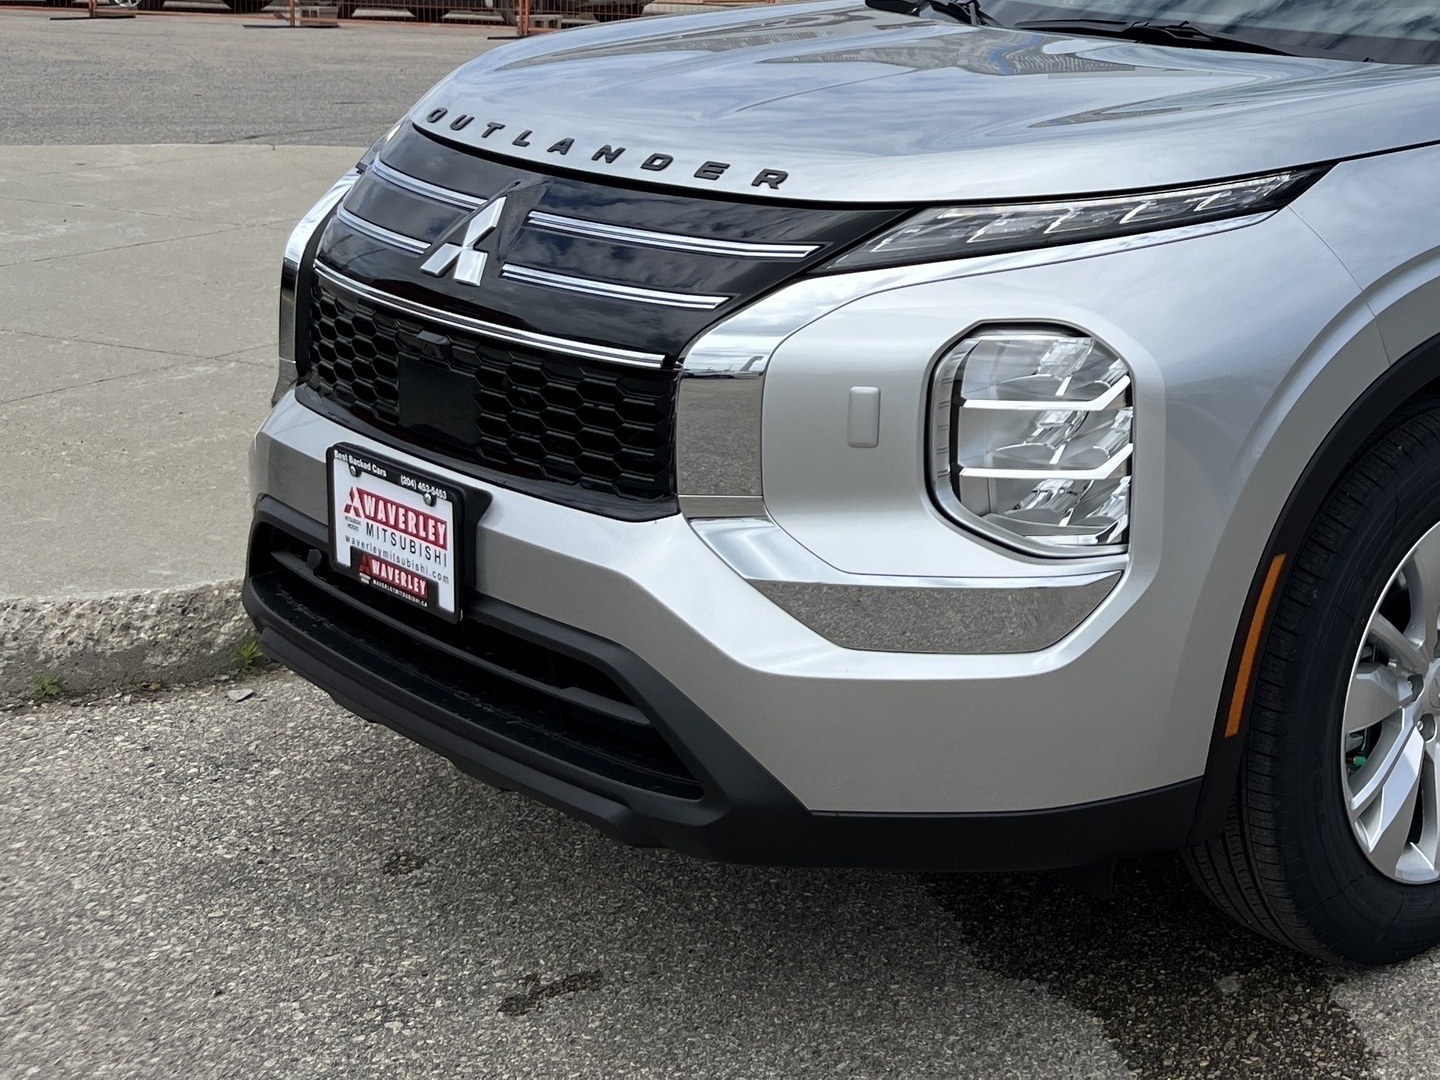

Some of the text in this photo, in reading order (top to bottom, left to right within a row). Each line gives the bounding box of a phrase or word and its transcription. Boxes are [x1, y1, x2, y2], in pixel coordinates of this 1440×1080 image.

[426, 107, 789, 190] OUTLANDER
[334, 450, 387, 477] Best Backed Cars
[401, 474, 416, 490] (204)
[364, 493, 446, 546] WAVERLEY
[345, 535, 449, 584] waverleymitsubishi.com
[366, 522, 447, 568] MITSUBISHI
[372, 559, 426, 595] WAVERLEY
